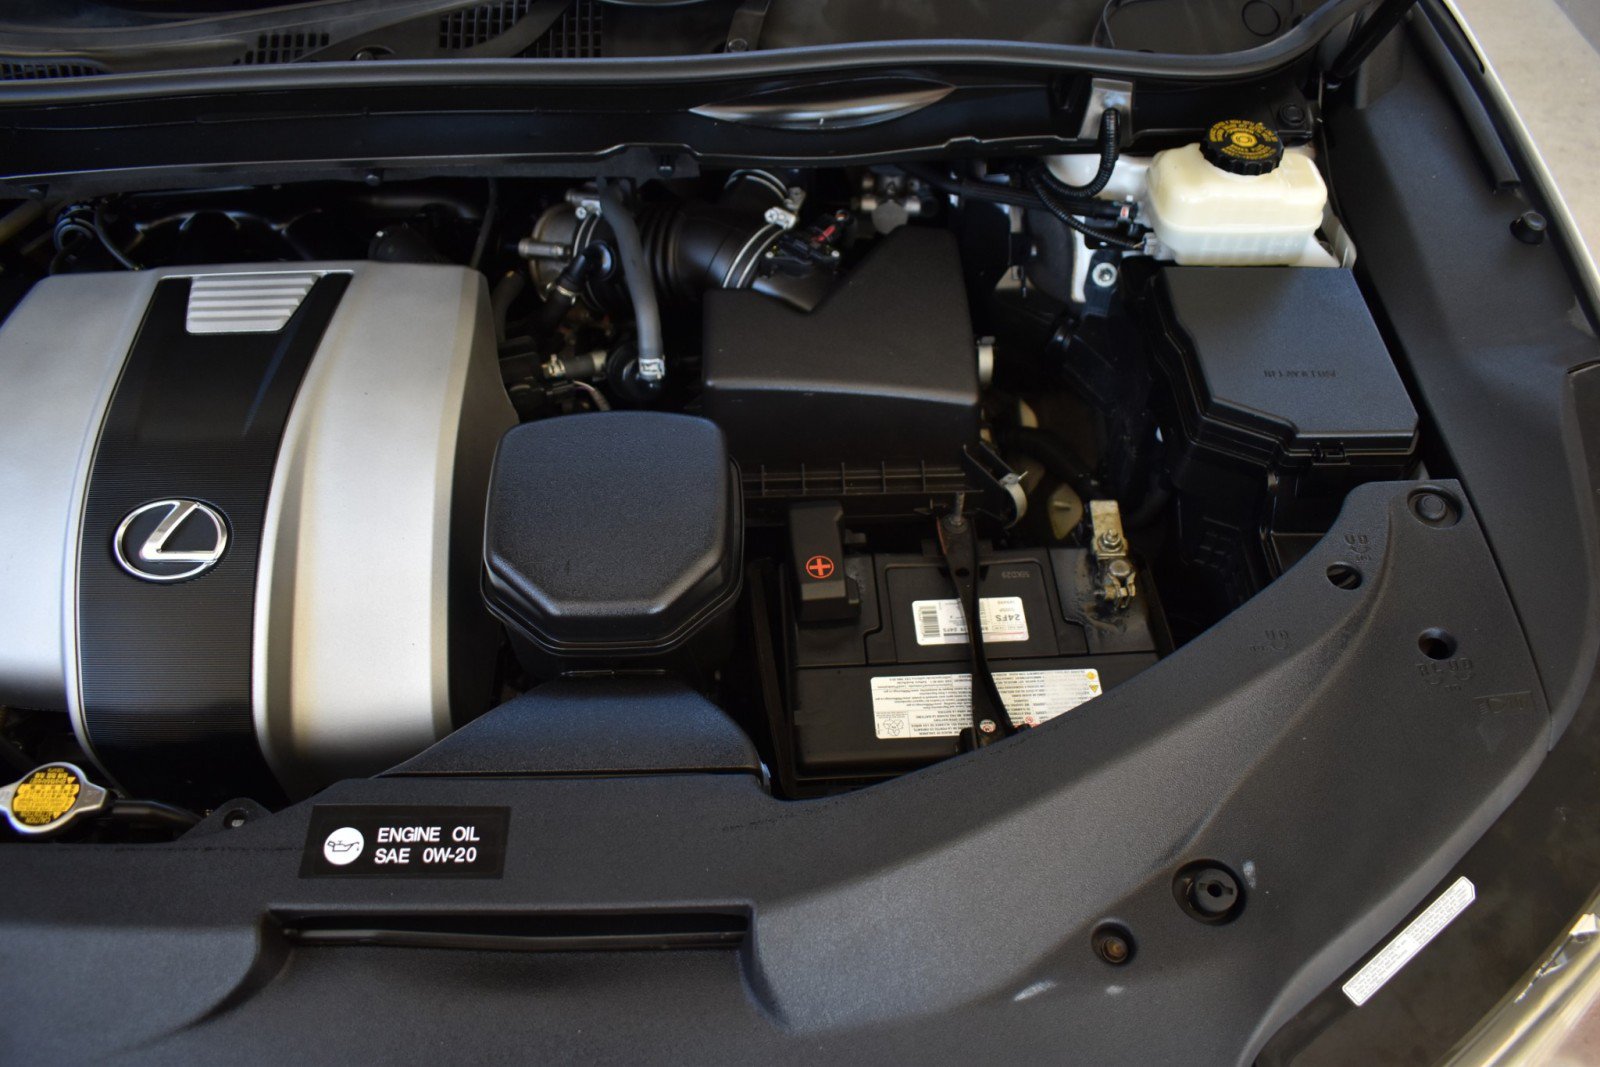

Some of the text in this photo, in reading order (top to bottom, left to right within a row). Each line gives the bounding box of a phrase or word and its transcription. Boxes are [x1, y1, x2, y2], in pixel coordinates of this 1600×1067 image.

[995, 614, 1020, 622] 24FS
[377, 826, 480, 843] ENGINE OIL
[373, 847, 478, 864] SAE 0W-20
